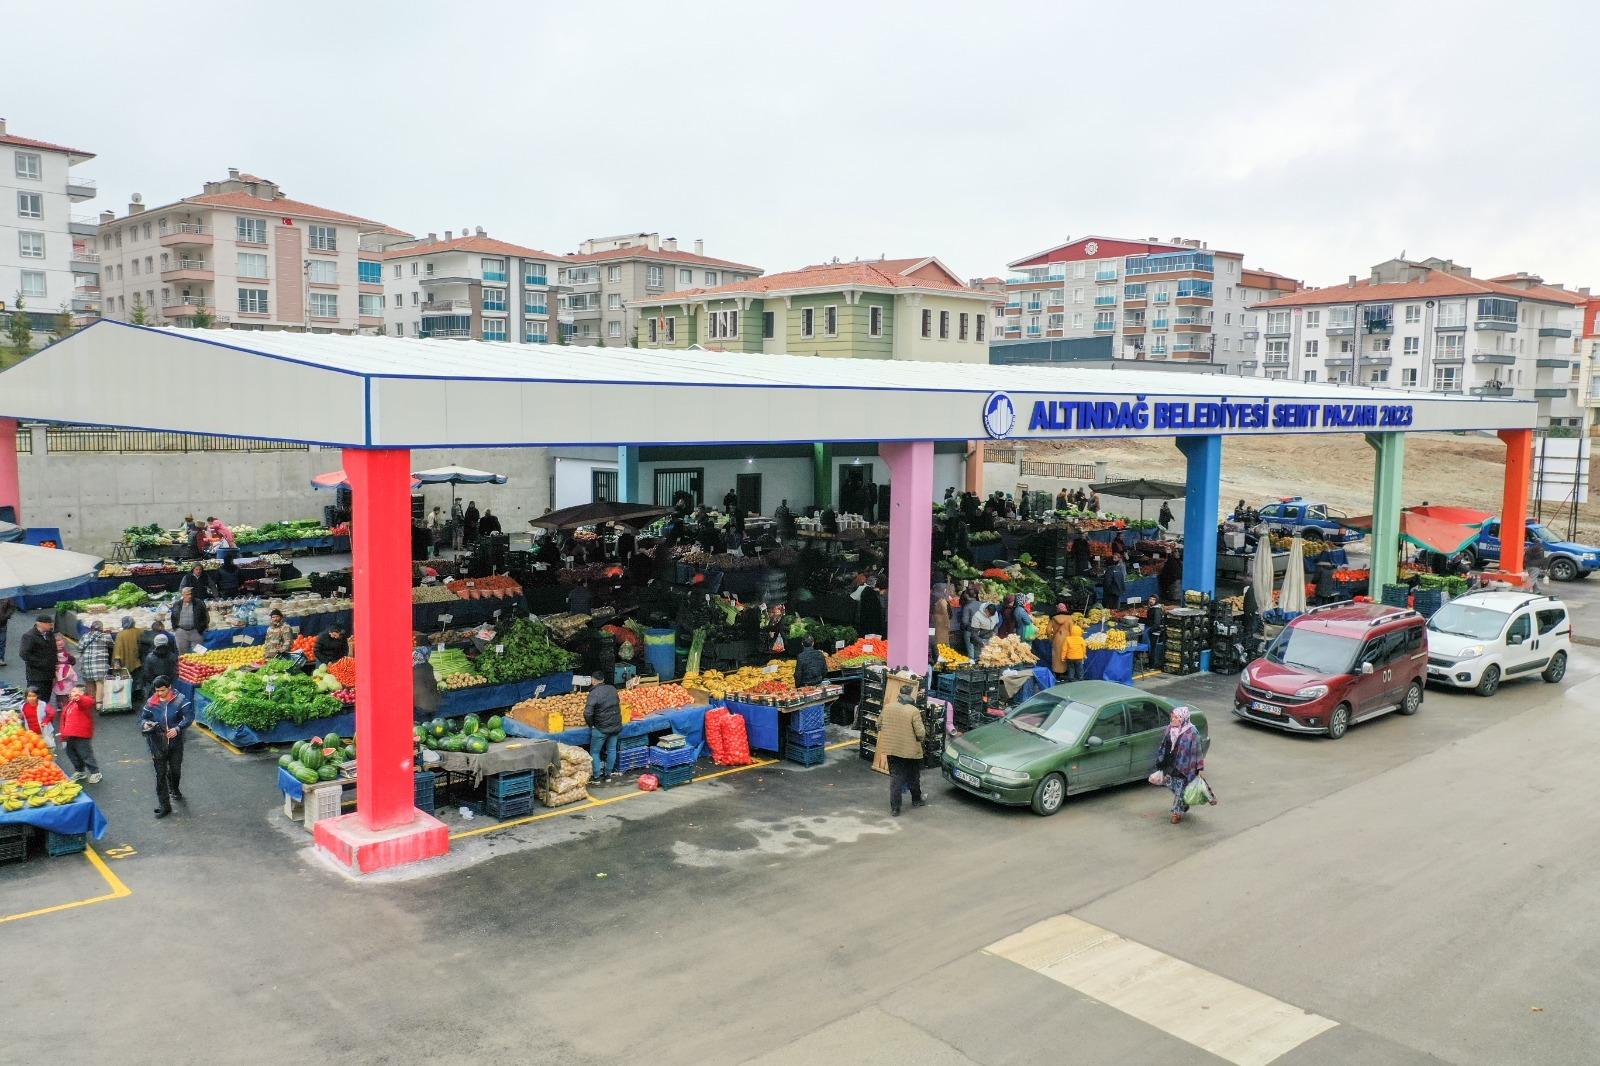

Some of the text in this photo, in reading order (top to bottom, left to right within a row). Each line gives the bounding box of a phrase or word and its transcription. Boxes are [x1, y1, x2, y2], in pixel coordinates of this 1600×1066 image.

[1029, 394, 1149, 430] ALTINDAĞ
[1154, 396, 1269, 429] BELEDİYESİ
[1273, 404, 1320, 427] SEMT
[1323, 405, 1378, 427] PAZARI
[1380, 405, 1413, 427] 2023
